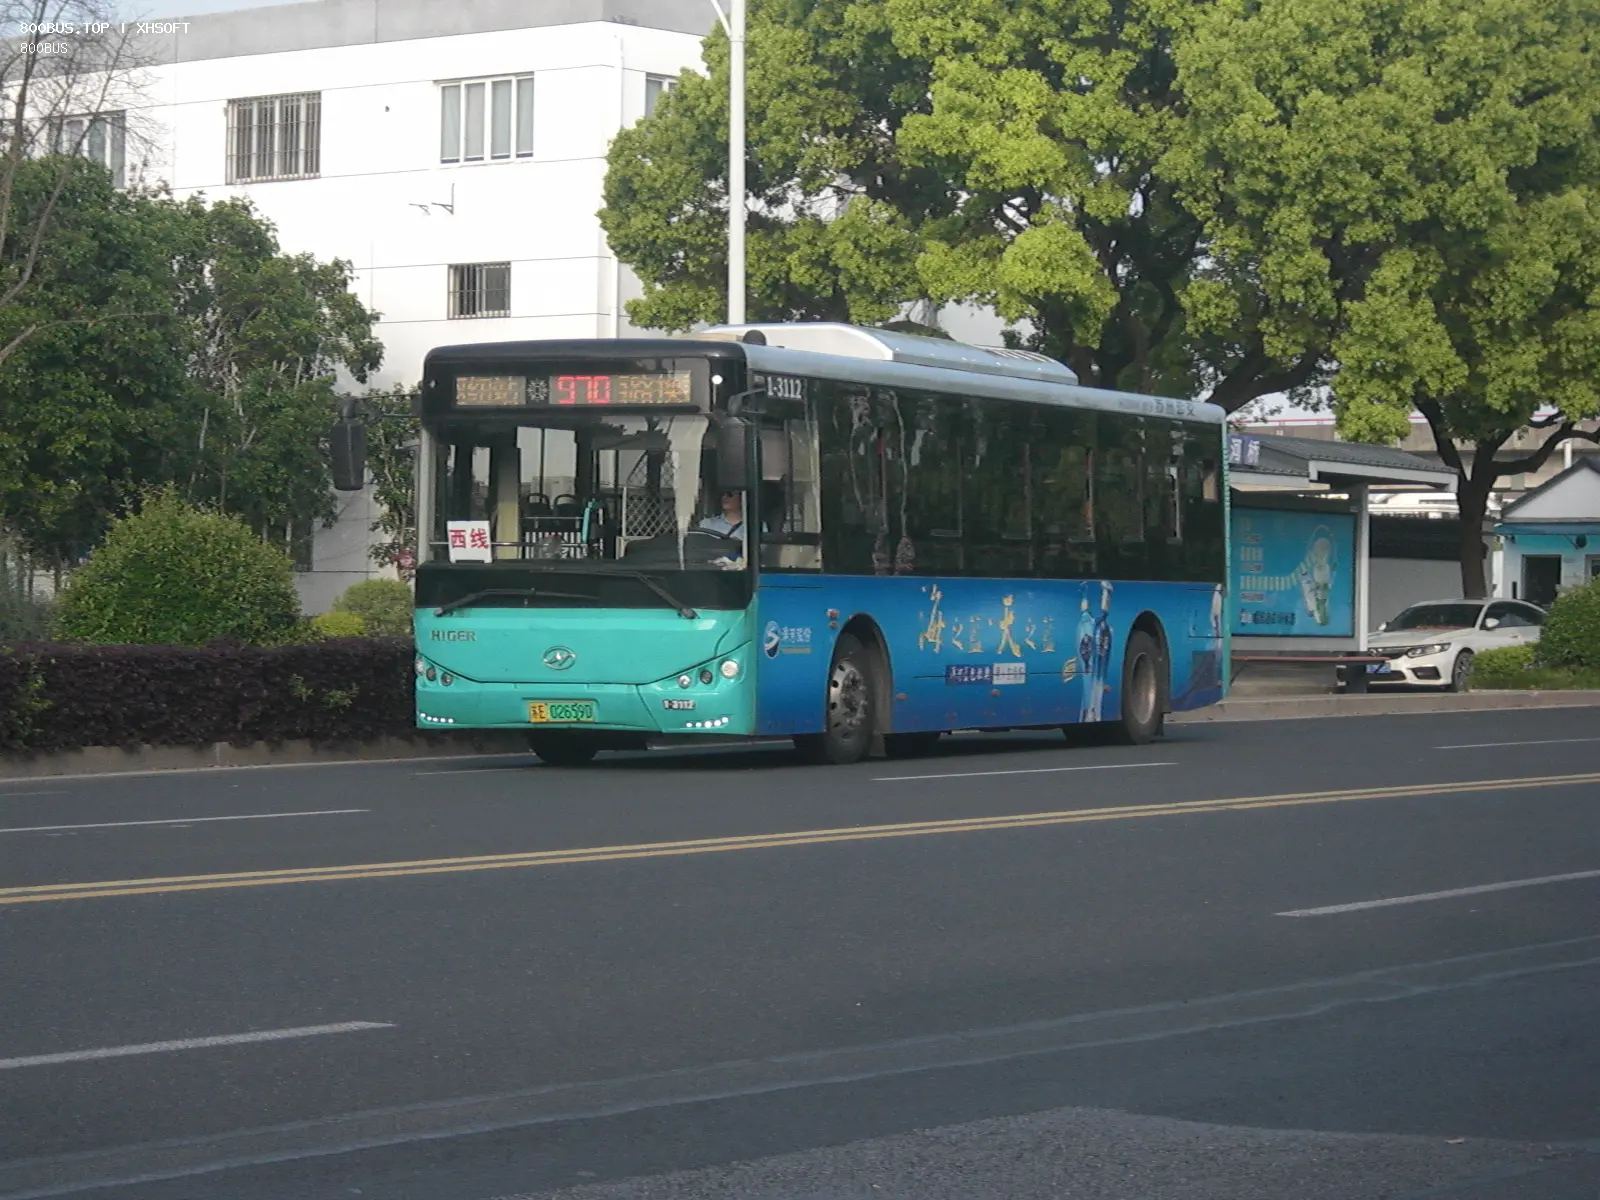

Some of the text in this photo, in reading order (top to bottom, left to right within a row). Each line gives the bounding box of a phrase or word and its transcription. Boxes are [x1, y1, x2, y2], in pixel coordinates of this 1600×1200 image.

[557, 375, 611, 404] 970
[448, 527, 490, 550] 西线
[431, 629, 477, 642] HIGER
